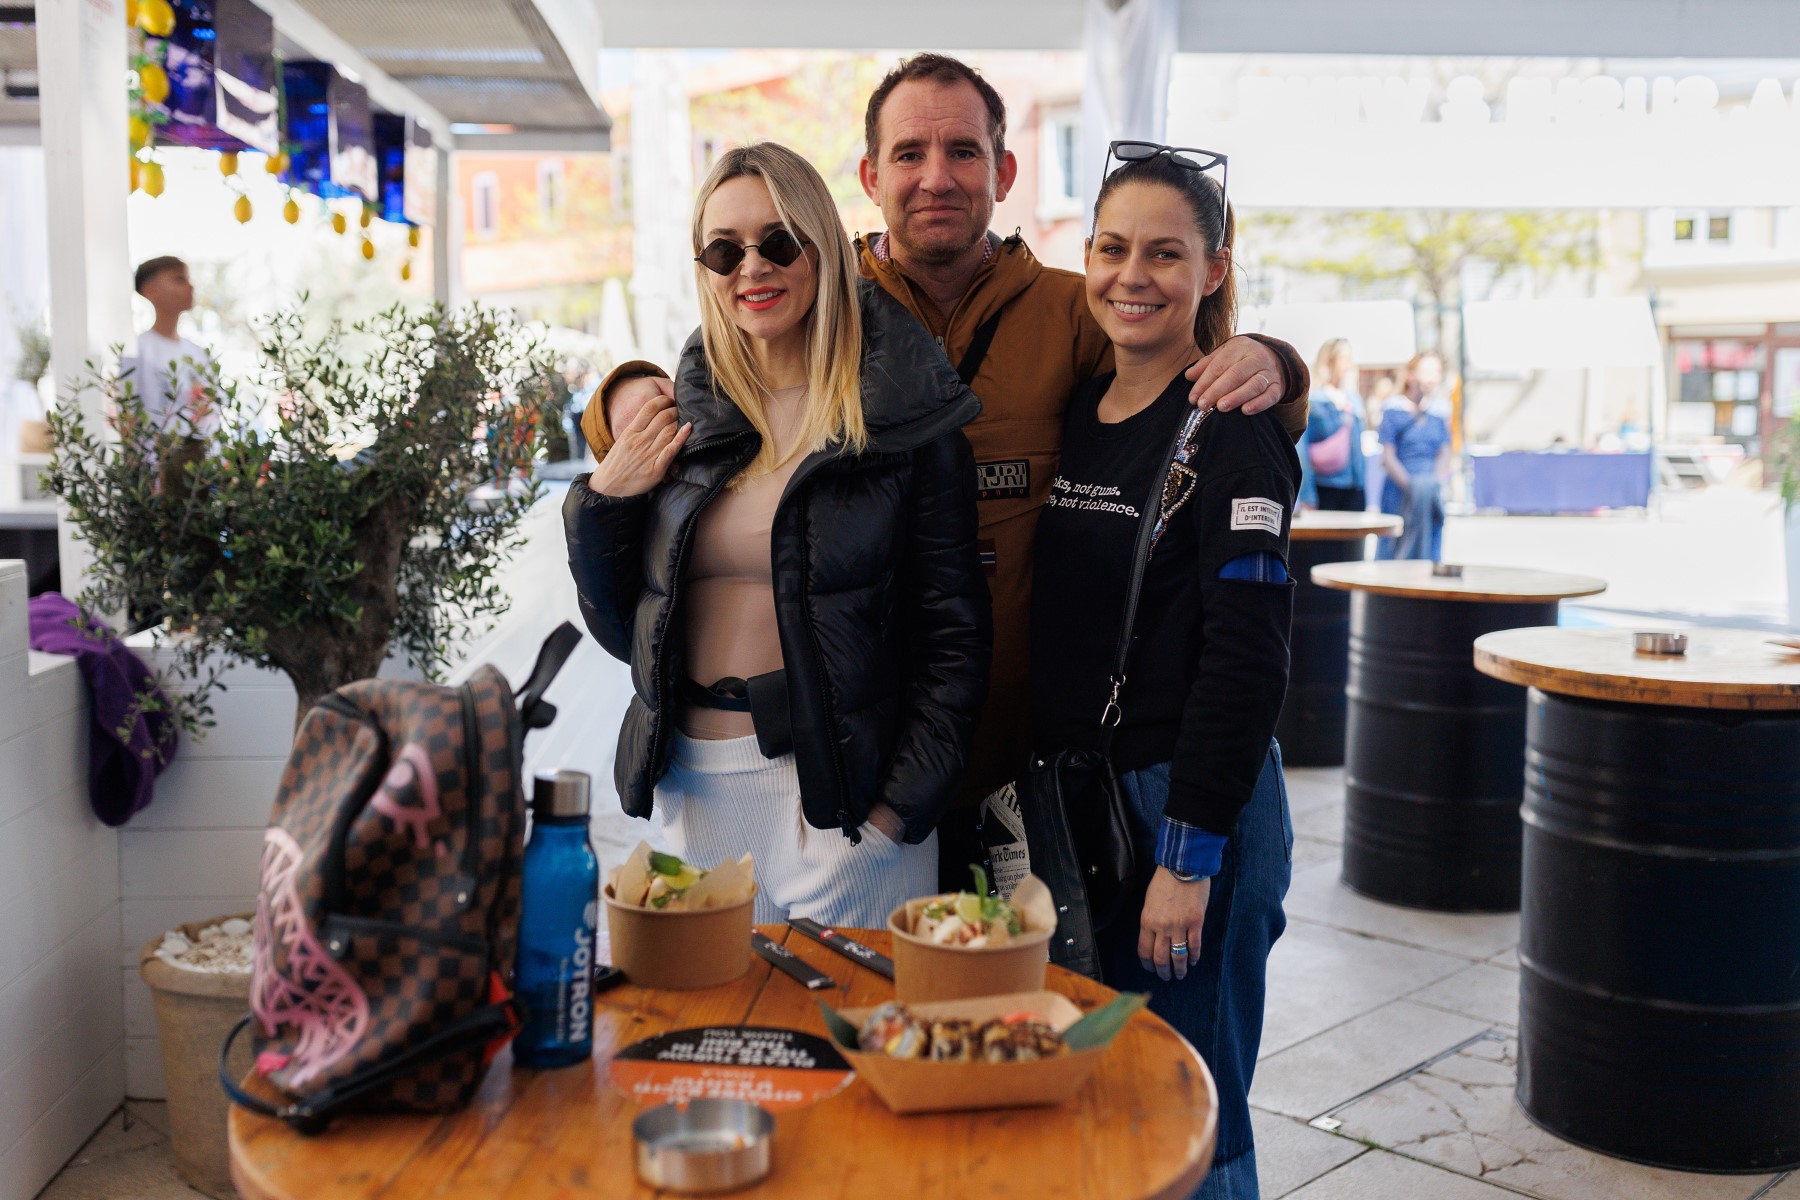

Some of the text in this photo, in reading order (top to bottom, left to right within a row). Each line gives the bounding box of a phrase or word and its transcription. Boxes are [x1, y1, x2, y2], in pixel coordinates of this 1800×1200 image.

[976, 464, 1026, 488] IJRI
[1072, 483, 1092, 494] not
[1090, 485, 1121, 497] guns.
[1058, 496, 1078, 508] not
[1078, 499, 1140, 518] violence.
[569, 927, 592, 1043] JOTRON
[702, 1028, 736, 1039] YOU
[737, 1055, 816, 1068] PLEASE
